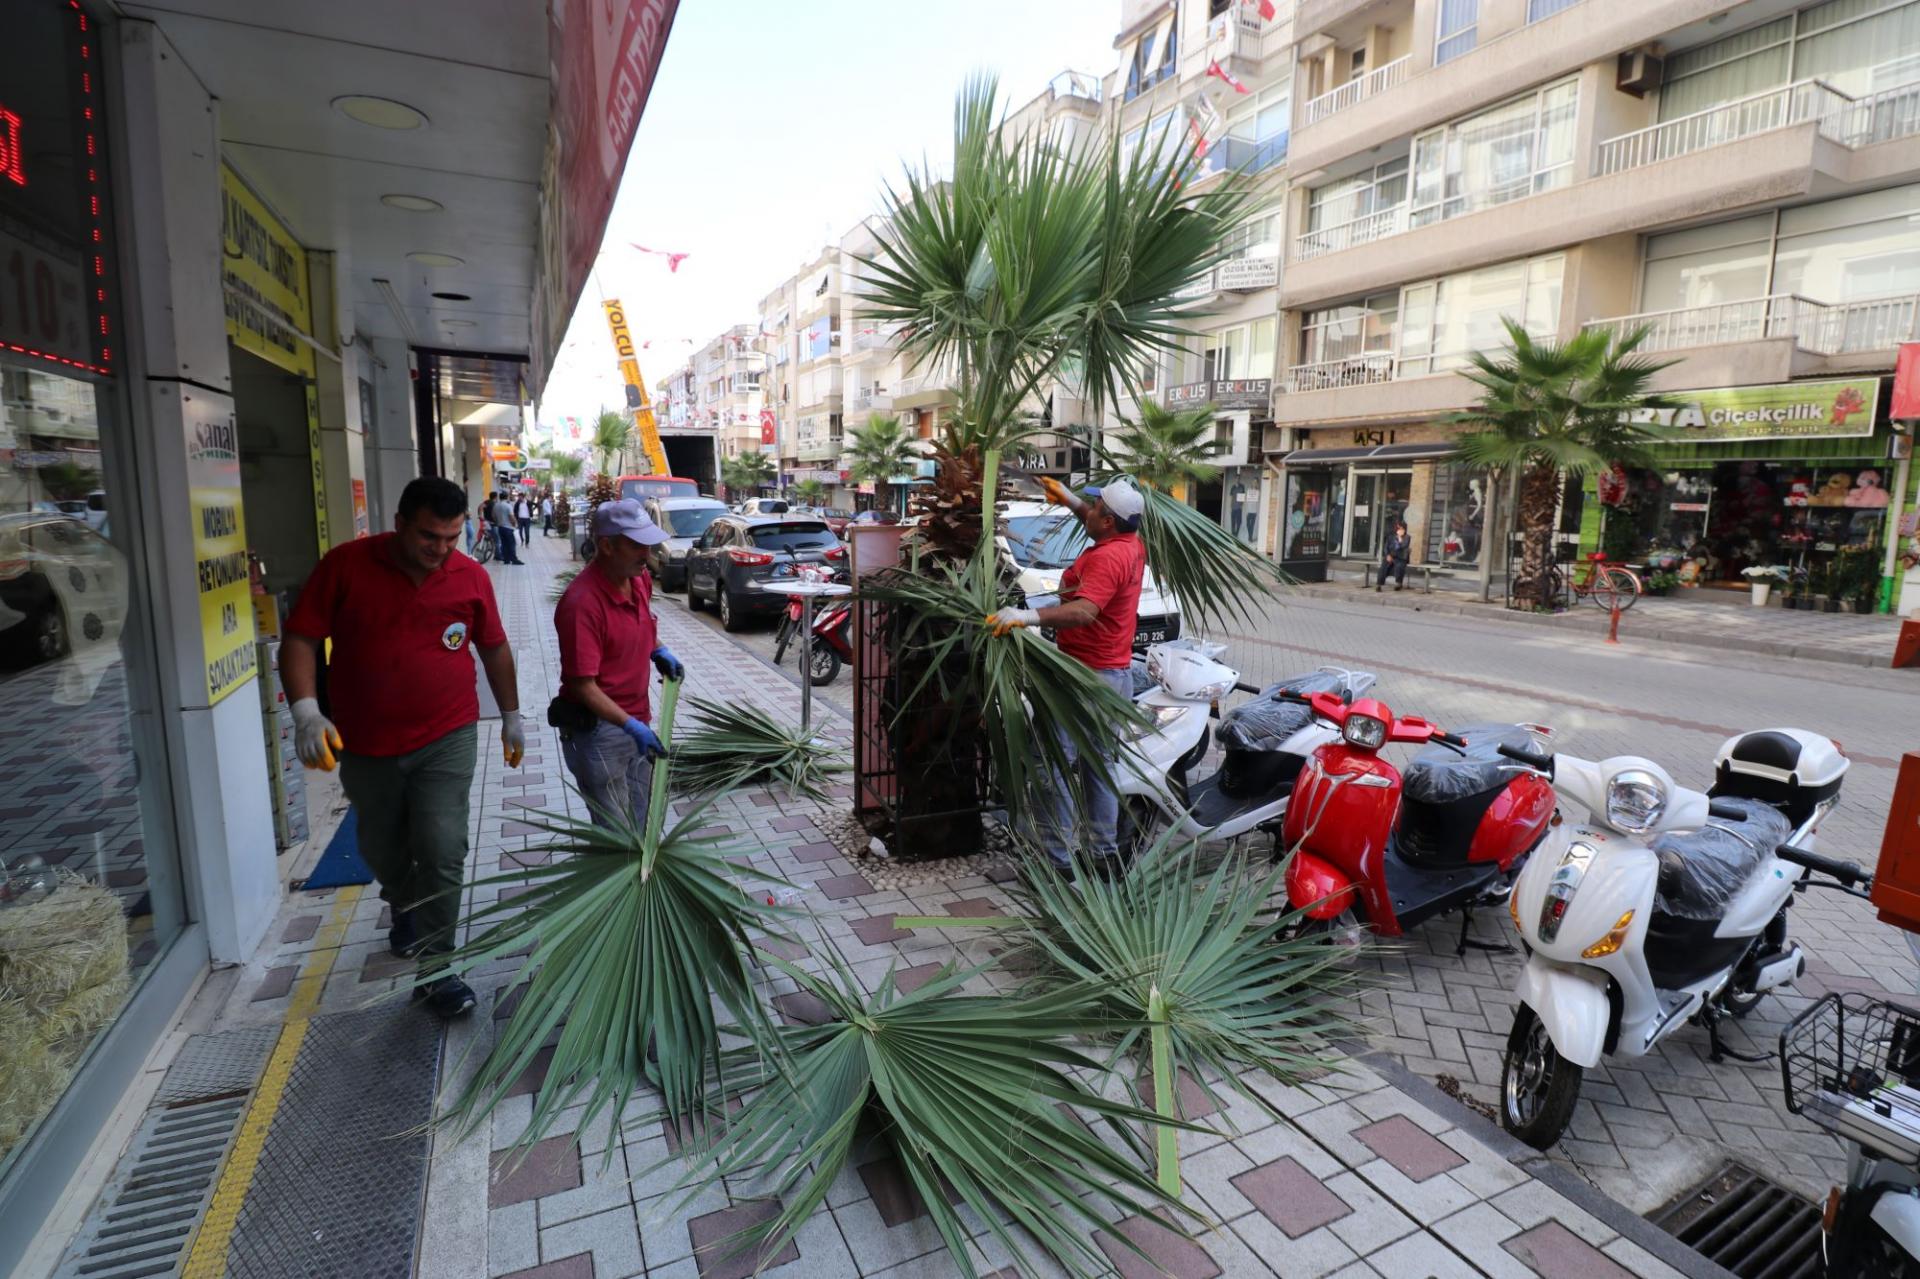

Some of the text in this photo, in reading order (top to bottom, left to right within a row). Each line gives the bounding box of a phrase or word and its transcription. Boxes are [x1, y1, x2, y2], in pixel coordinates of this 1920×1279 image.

[605, 298, 634, 357] YOLCU
[1216, 380, 1266, 394] ERKUŞ
[1709, 403, 1824, 425] Çiçekçilik
[195, 419, 235, 452] Sanal
[222, 601, 238, 636] ARA
